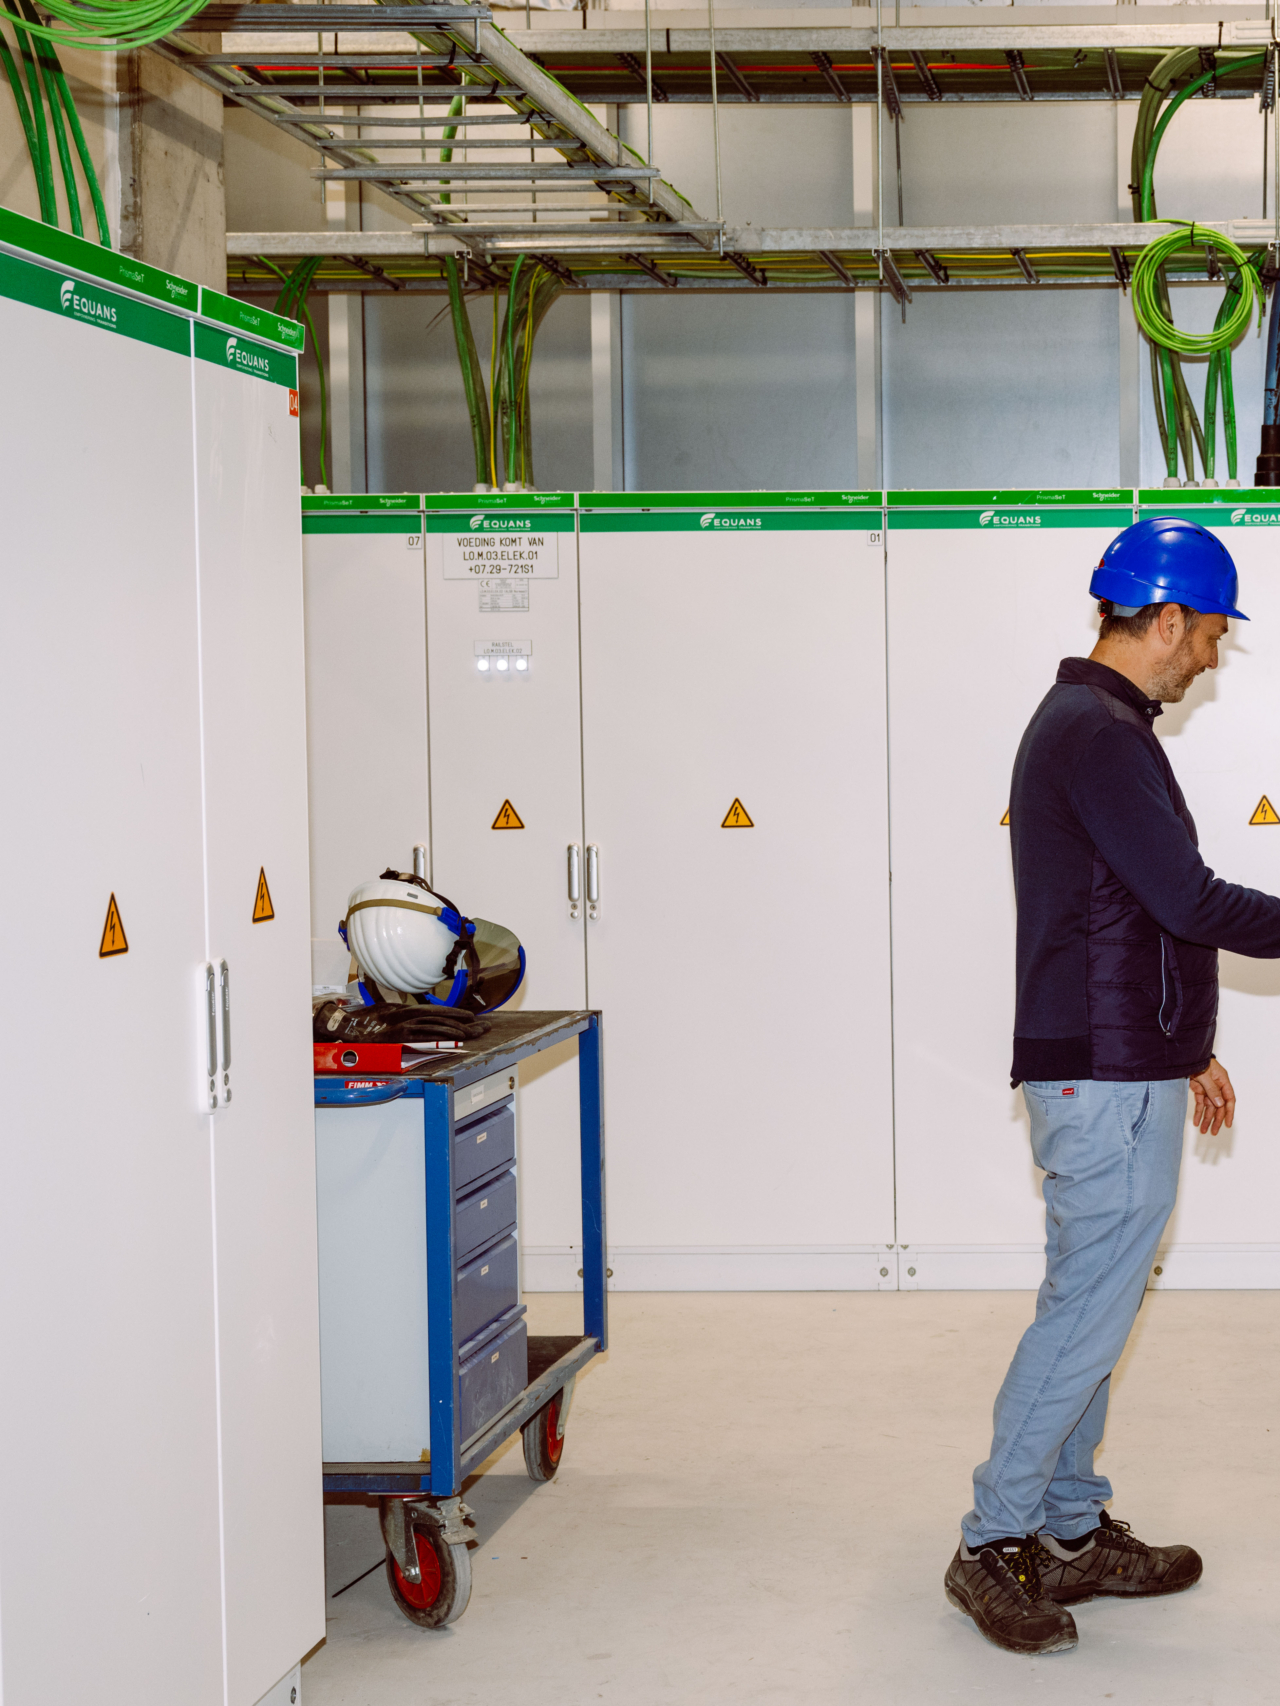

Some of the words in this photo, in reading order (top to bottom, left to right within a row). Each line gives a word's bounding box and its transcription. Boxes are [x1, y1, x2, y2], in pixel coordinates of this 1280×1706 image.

[165, 279, 188, 296] Schneider
[73, 294, 117, 322] EQUANS
[236, 349, 269, 372] EQUANS
[290, 394, 298, 412] 04
[534, 495, 561, 503] Schneider
[841, 494, 869, 502] Schneider
[1092, 492, 1120, 500] Schneider
[379, 498, 407, 506] Schneider
[483, 520, 531, 528] EQUANS
[713, 518, 762, 527] EQUANS
[993, 516, 1041, 524] EQUANS
[408, 536, 420, 546] 07
[457, 537, 496, 547] VOEDING
[499, 537, 522, 547] KOMT
[527, 536, 544, 547] VAN
[870, 533, 880, 543] 01
[468, 564, 534, 575] +07.29-721S1
